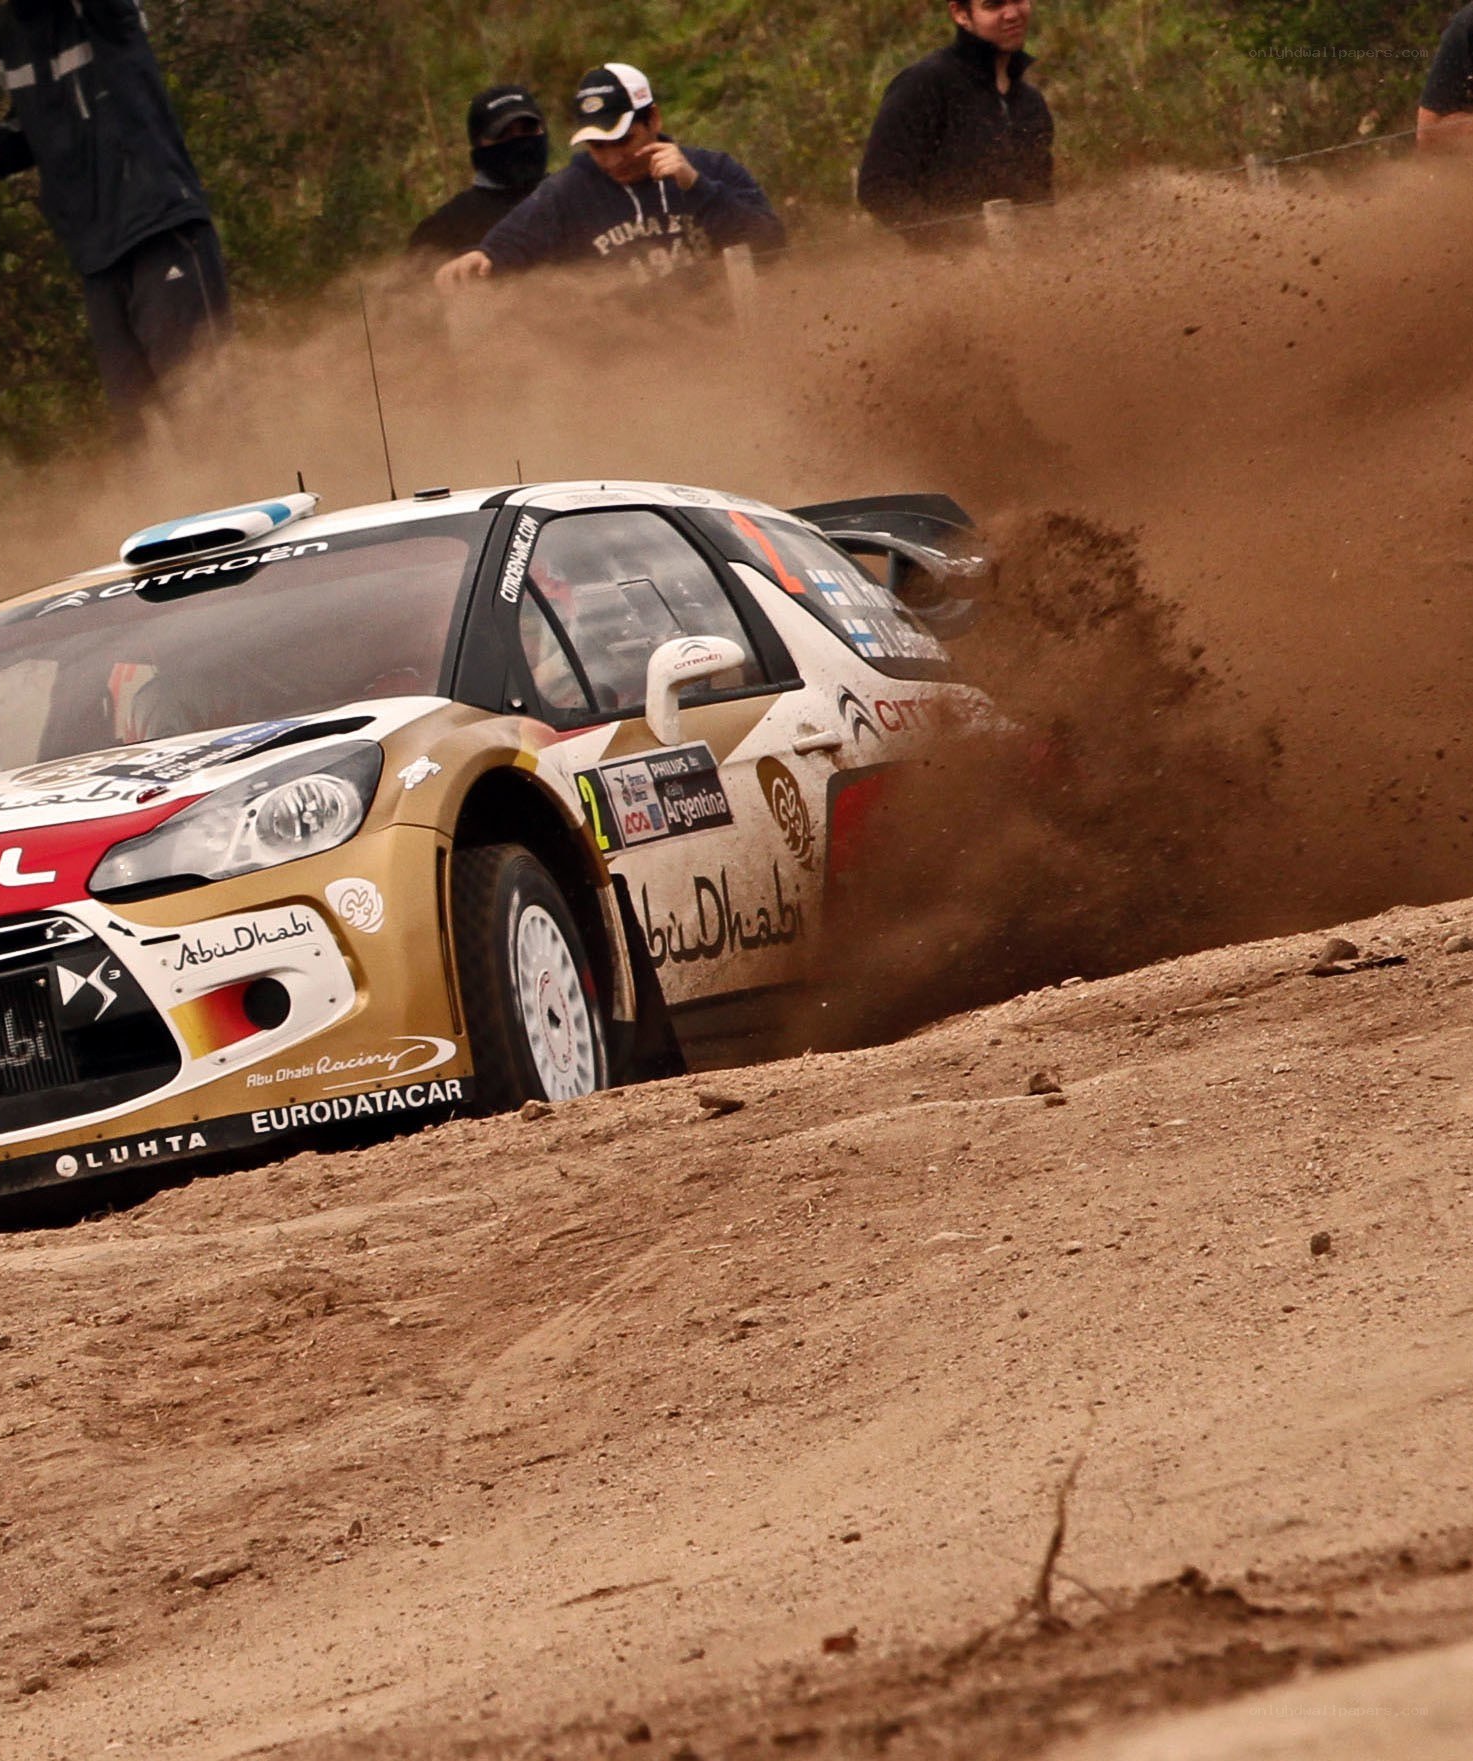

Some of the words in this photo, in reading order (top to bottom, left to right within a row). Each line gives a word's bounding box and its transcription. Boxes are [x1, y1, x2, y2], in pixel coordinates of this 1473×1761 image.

[592, 216, 663, 256] PUMA
[650, 756, 690, 778] PHILIPS
[663, 788, 728, 827] Argentina
[246, 1073, 273, 1088] Abu
[275, 1065, 315, 1082] Dhabi
[316, 1045, 426, 1074] Racing
[251, 1079, 463, 1133] EURODATACAR
[86, 1132, 208, 1168] LUHTA
